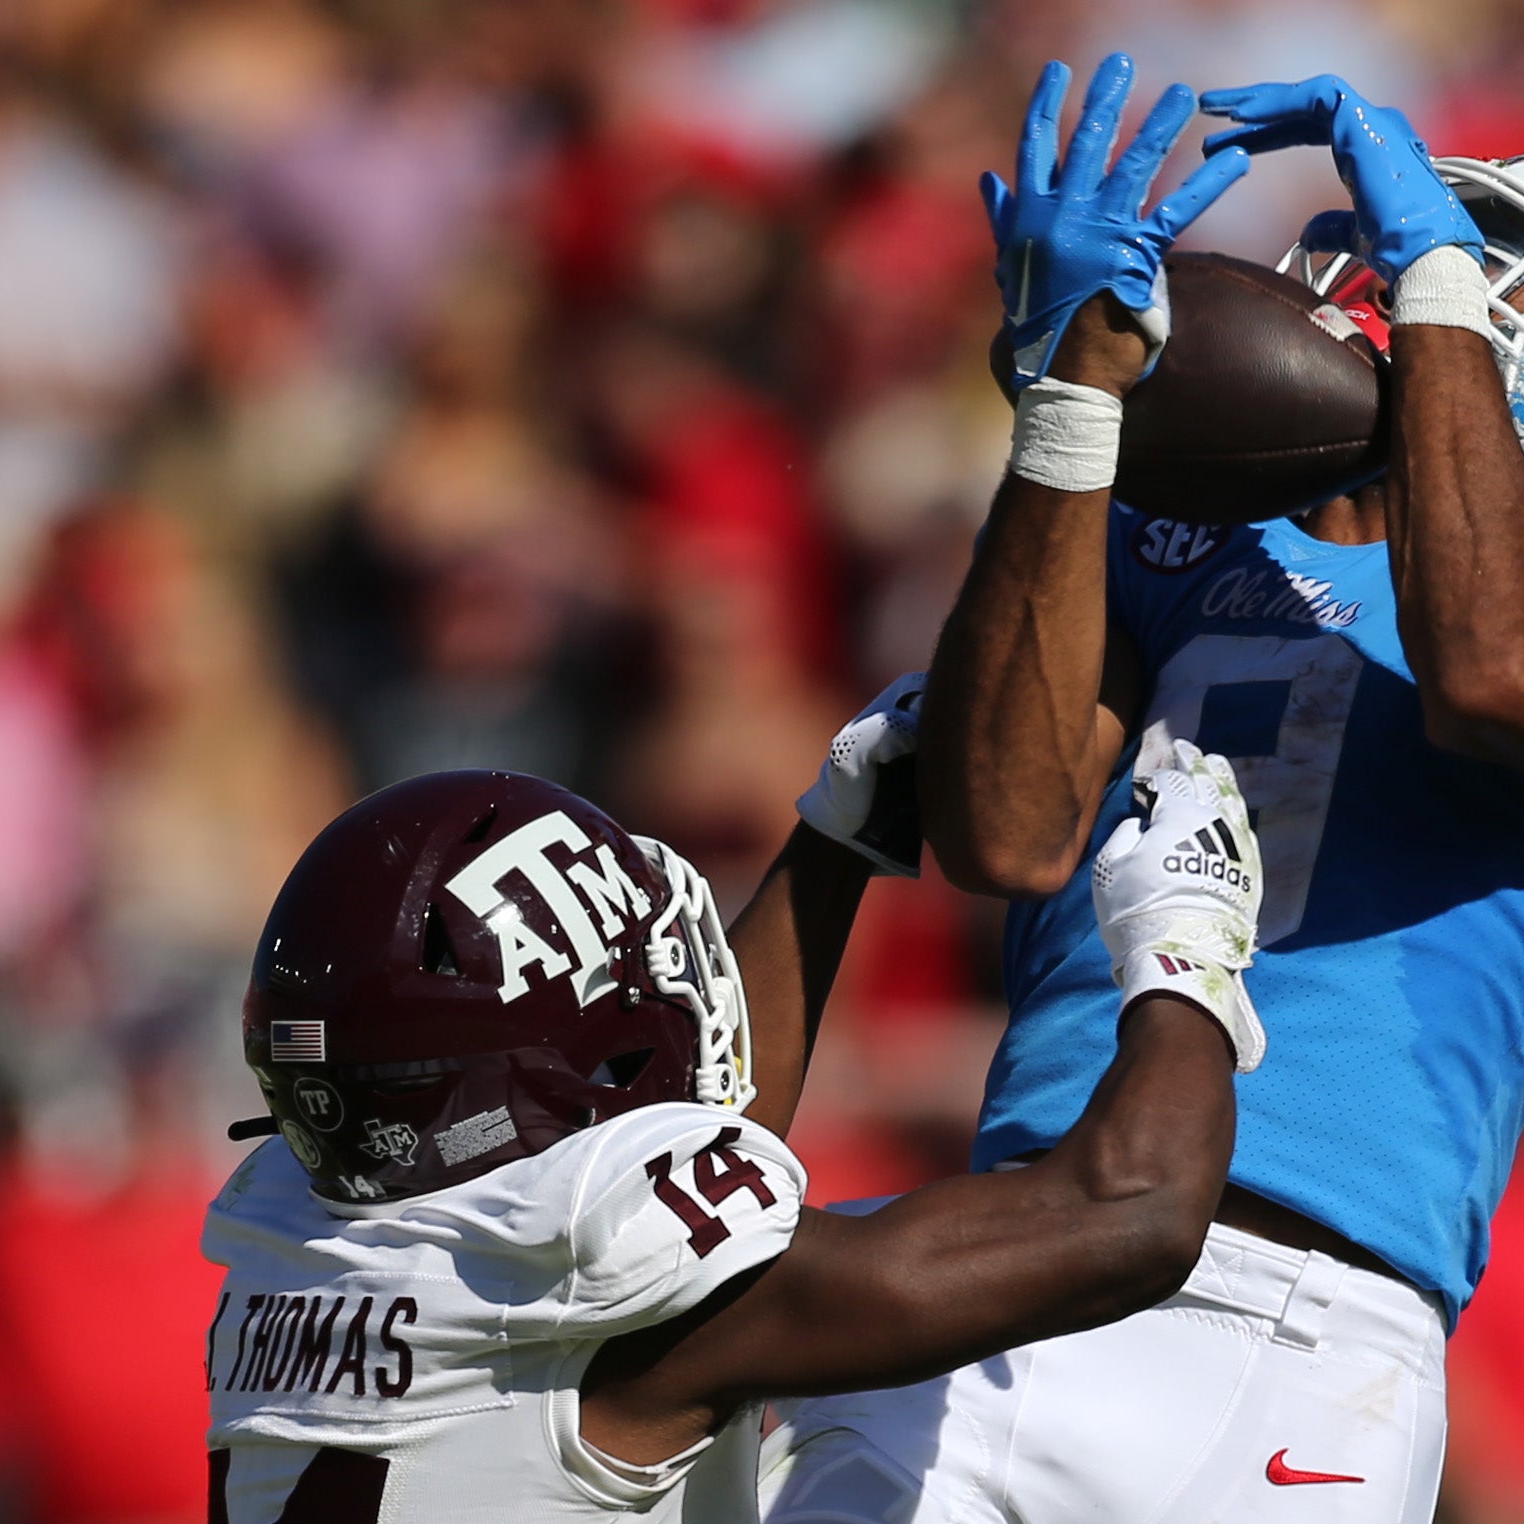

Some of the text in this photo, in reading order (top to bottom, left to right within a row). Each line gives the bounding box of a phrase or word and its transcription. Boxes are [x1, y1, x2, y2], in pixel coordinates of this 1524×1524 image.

[1162, 852, 1252, 893] adidas
[299, 1089, 330, 1115] TP
[337, 1174, 376, 1199] 14
[643, 1125, 779, 1260] 14
[224, 1293, 419, 1399] THOMAS
